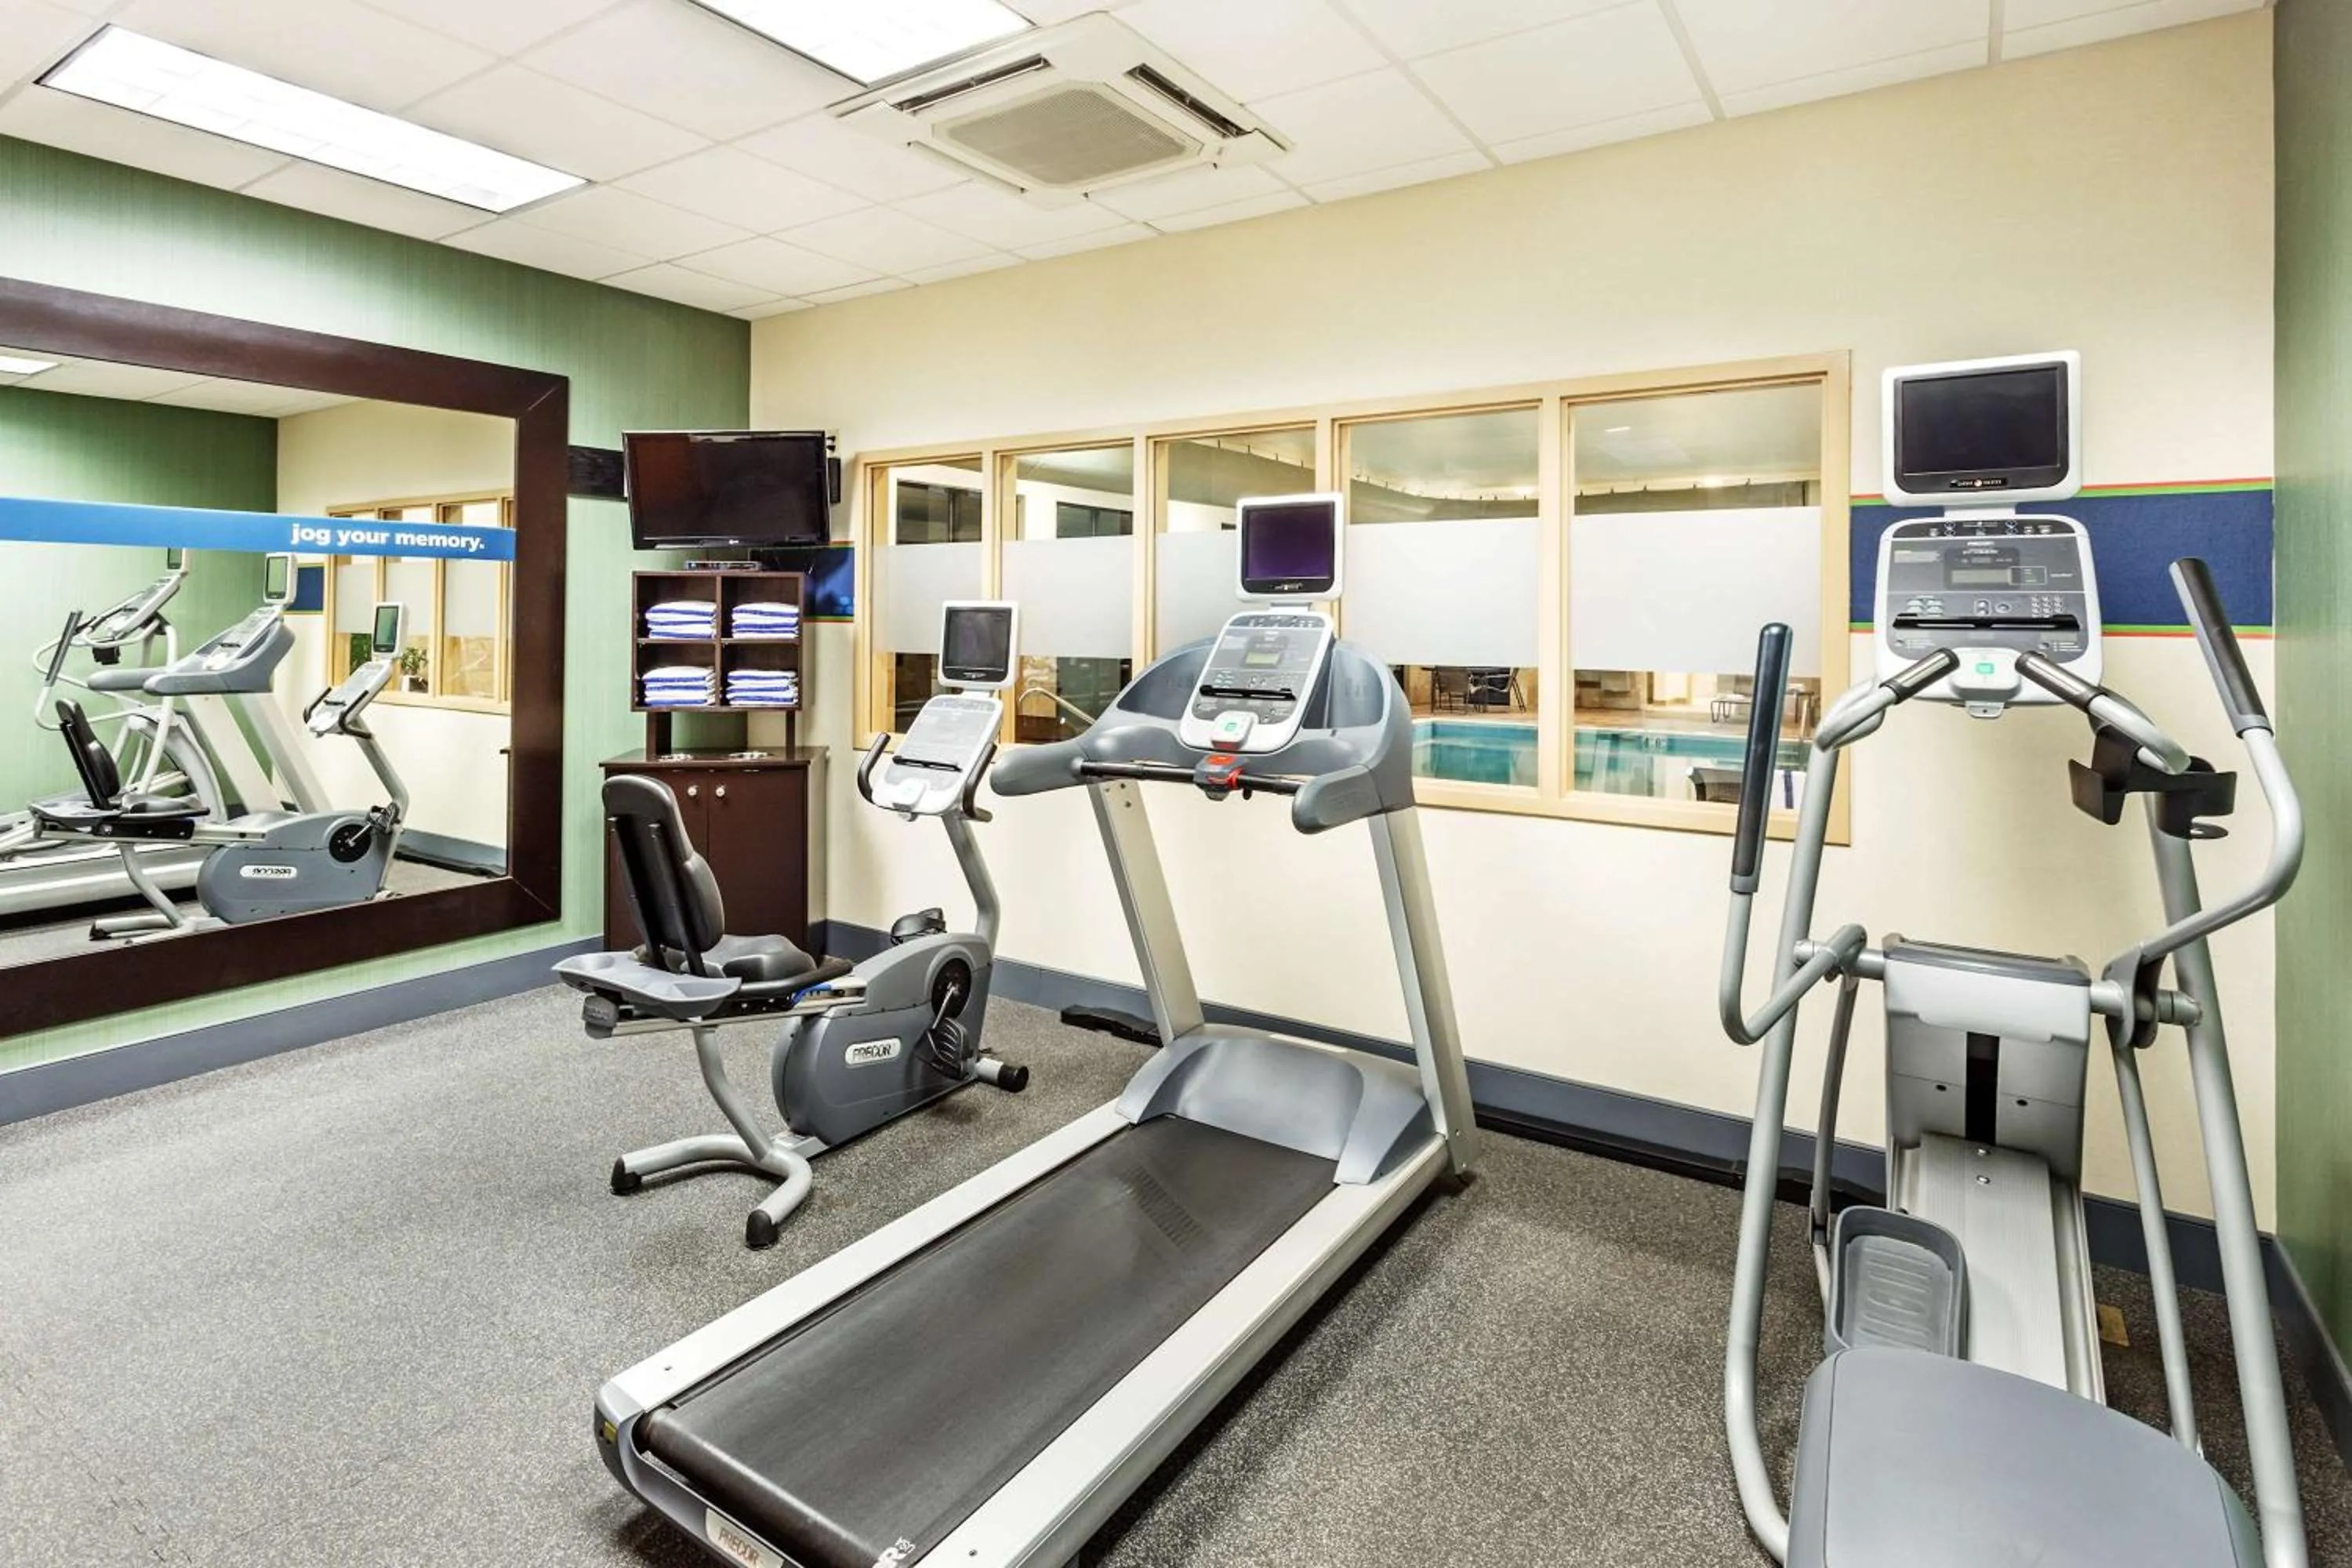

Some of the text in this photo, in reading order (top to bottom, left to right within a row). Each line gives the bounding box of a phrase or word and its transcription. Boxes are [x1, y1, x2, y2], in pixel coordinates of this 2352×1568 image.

[290, 523, 485, 551] jog your memory.
[717, 1526, 759, 1566] PRECOR
